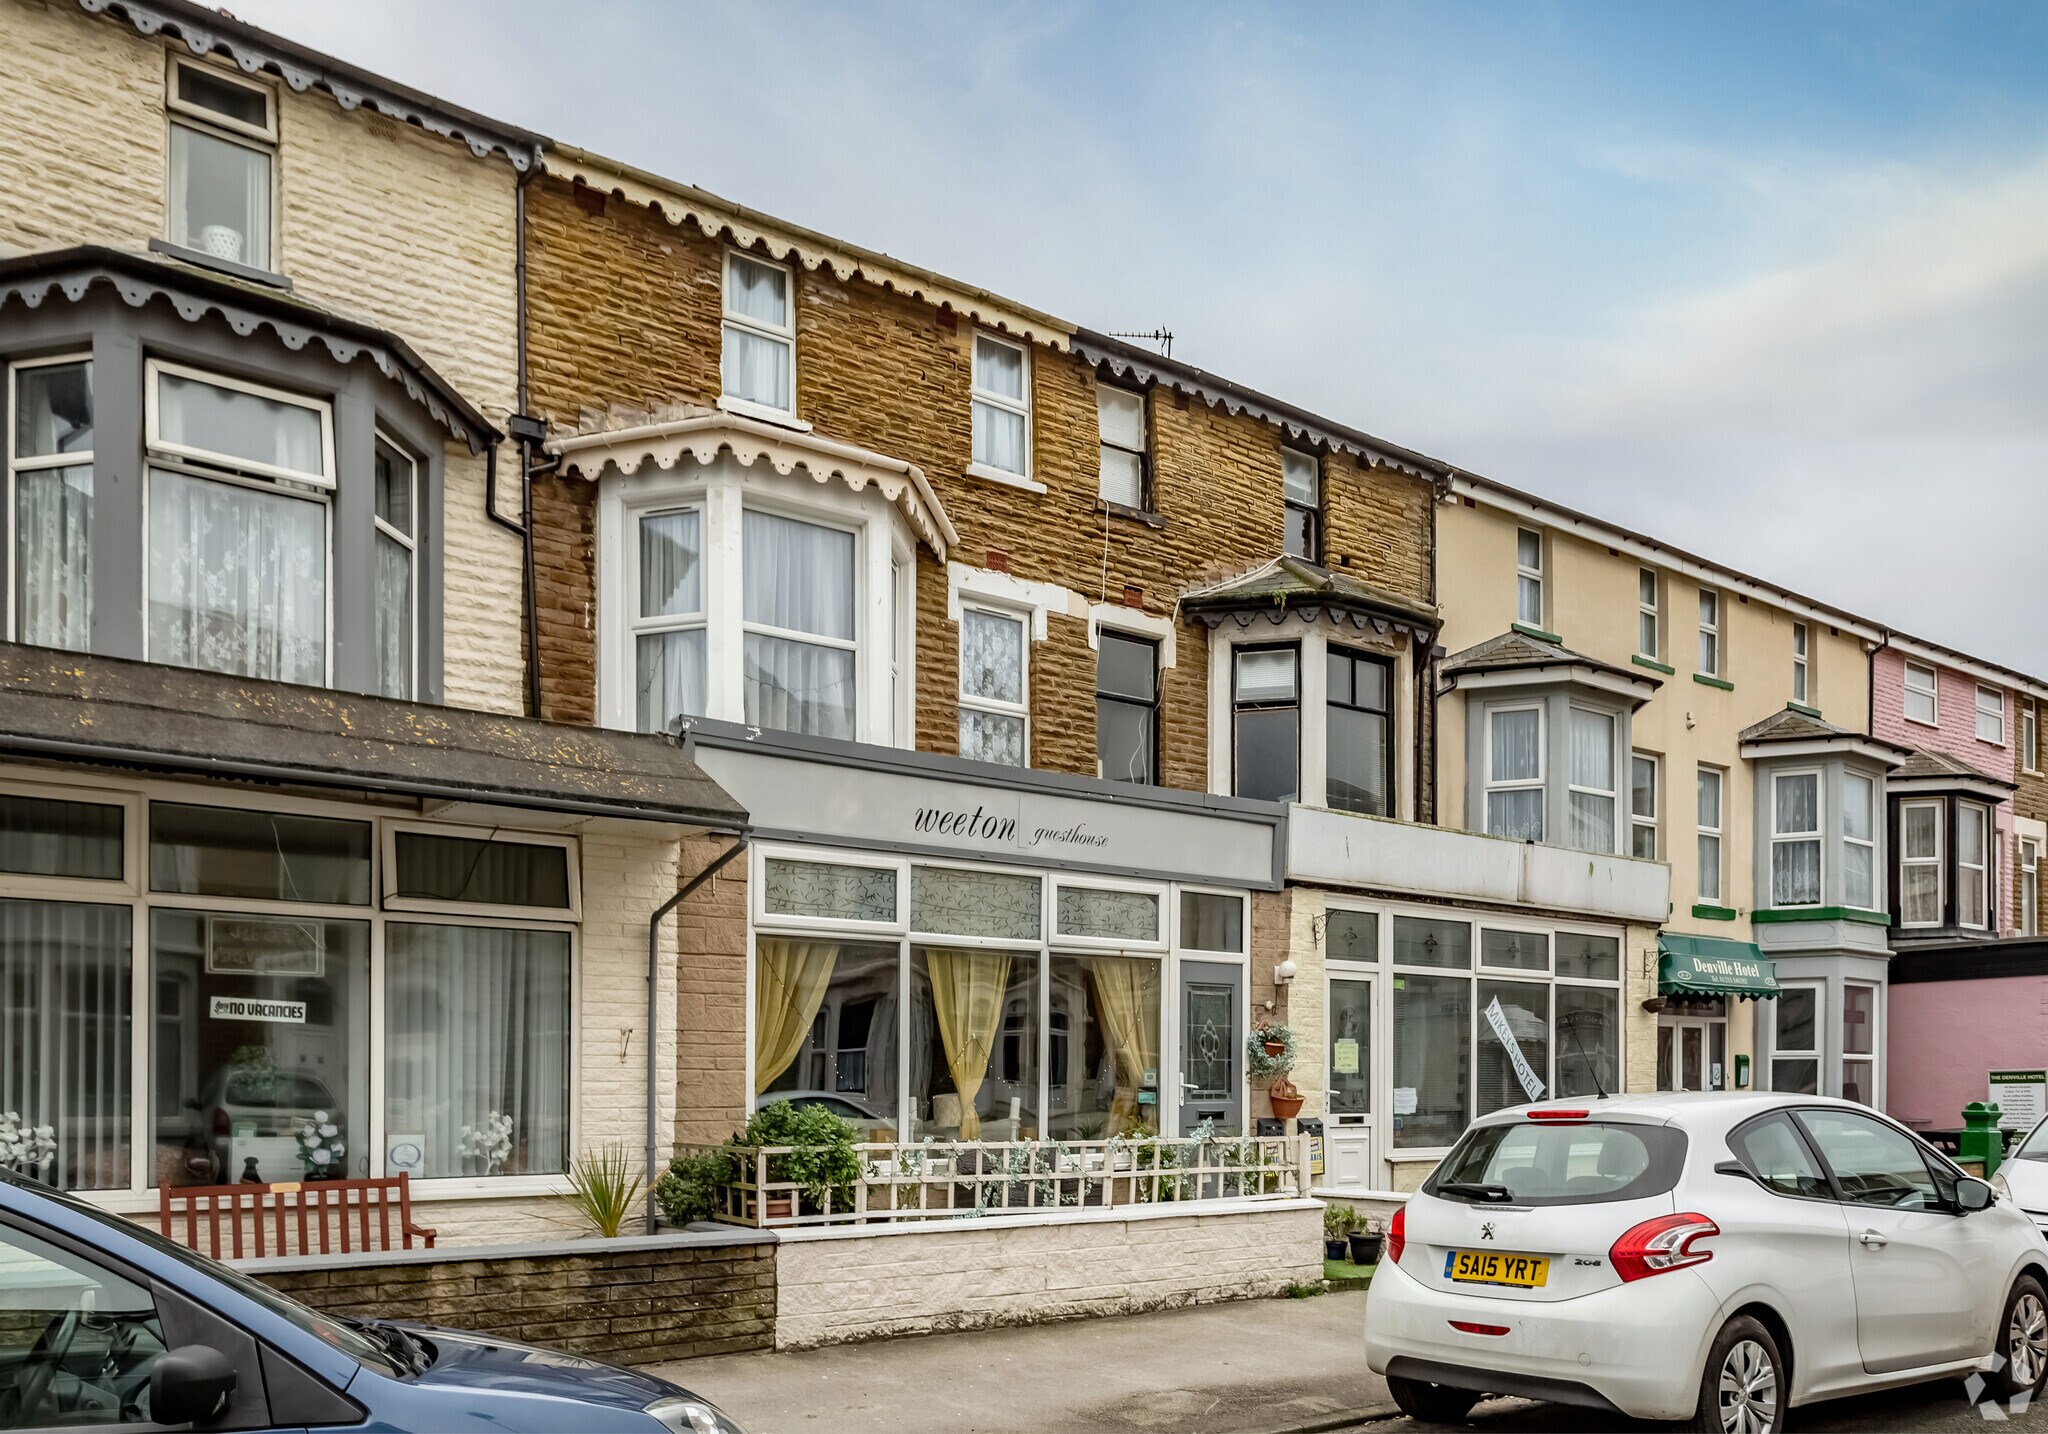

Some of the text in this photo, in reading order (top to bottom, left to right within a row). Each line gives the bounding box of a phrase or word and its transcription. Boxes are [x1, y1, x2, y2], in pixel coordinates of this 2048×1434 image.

[914, 805, 1110, 848] weeton guesthouse
[1692, 958, 1760, 978] Denville Hotel
[229, 1001, 245, 1015] NO
[247, 1003, 303, 1019] VACANCIES
[1513, 1053, 1538, 1098] HOTEL
[1458, 1254, 1542, 1281] SA15 YRT
[1574, 1258, 1602, 1267] 208
